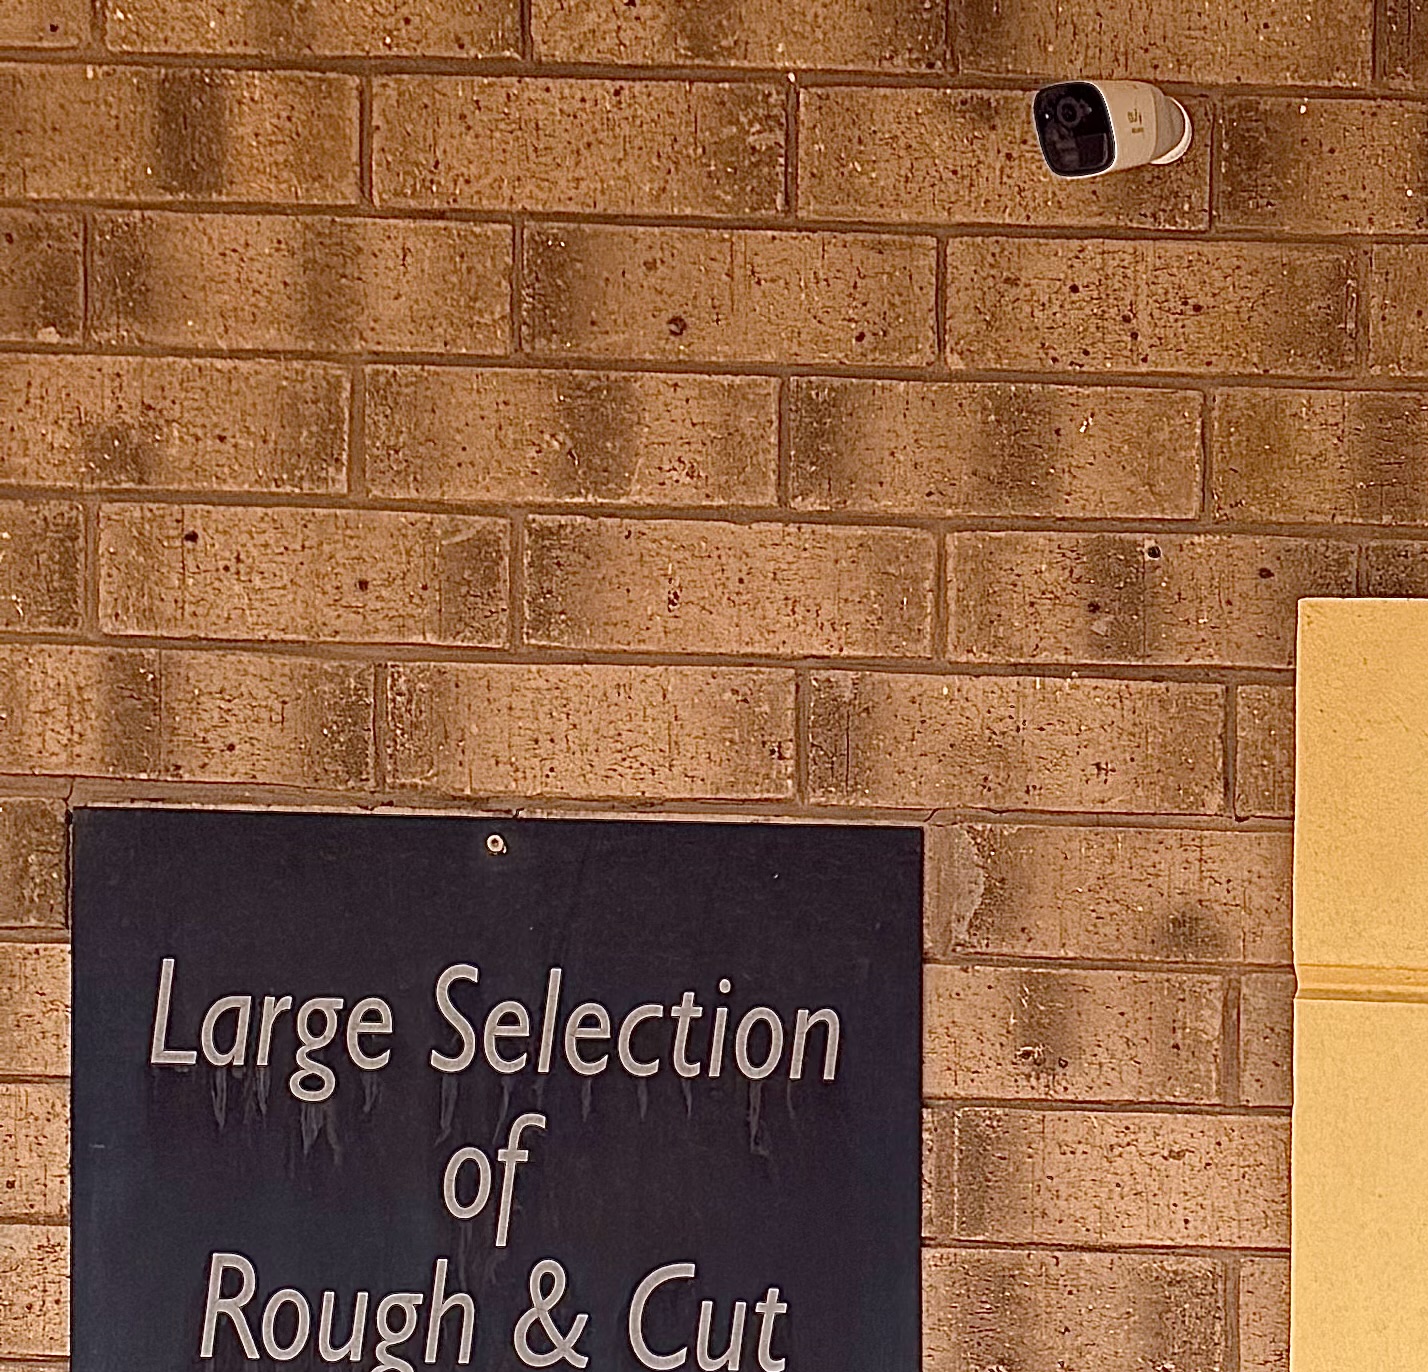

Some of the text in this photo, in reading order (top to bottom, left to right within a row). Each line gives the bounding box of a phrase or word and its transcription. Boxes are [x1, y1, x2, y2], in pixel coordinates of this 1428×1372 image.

[151, 958, 841, 1101] Large Selection
[443, 1113, 547, 1247] of
[514, 1259, 590, 1370] &
